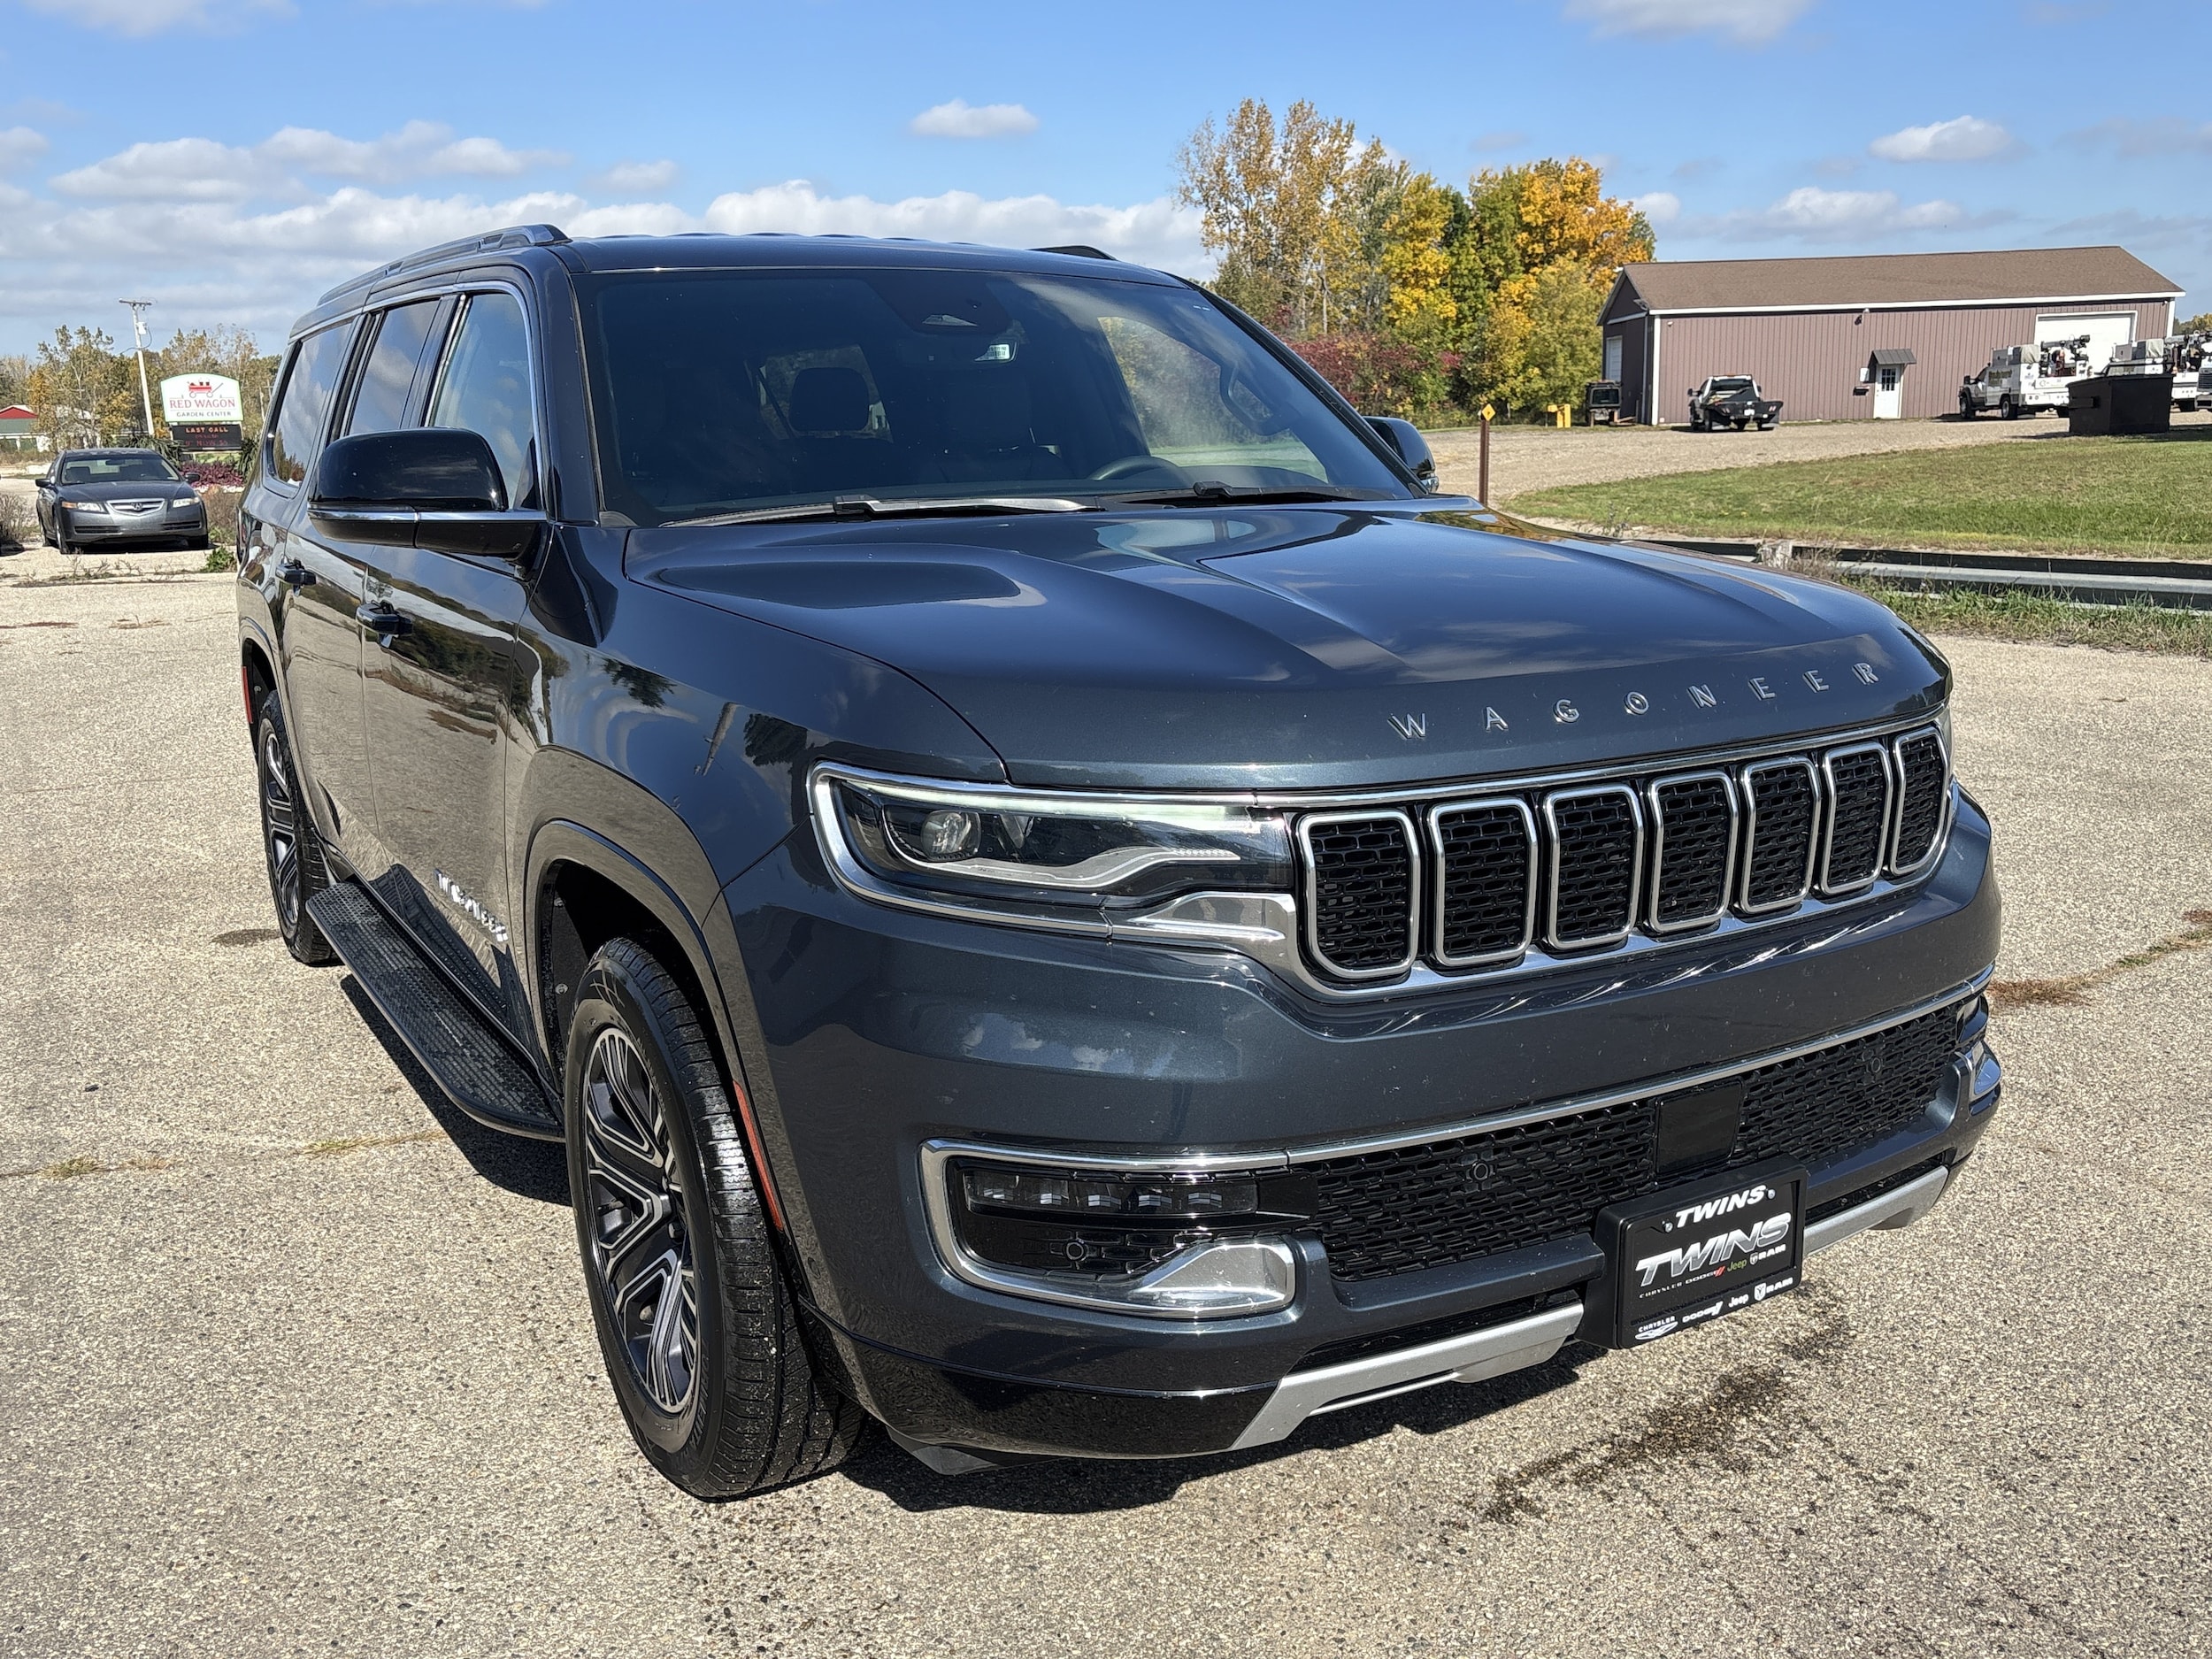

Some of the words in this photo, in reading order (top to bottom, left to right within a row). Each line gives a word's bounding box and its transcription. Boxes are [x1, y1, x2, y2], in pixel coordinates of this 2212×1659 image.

[170, 399, 192, 409] RED
[194, 398, 235, 409] WAGON
[1387, 661, 1879, 741] WAGONEER
[1676, 1185, 1766, 1228] TWINS
[1635, 1212, 1792, 1287] TWINS
[1639, 1281, 1683, 1299] CHRYSLER
[1727, 1258, 1747, 1272] Jeep
[1758, 1244, 1786, 1261] RAM
[1638, 1316, 1676, 1333] CHRYSLER
[1728, 1294, 1749, 1308] Jeep
[1766, 1277, 1793, 1294] RAM
